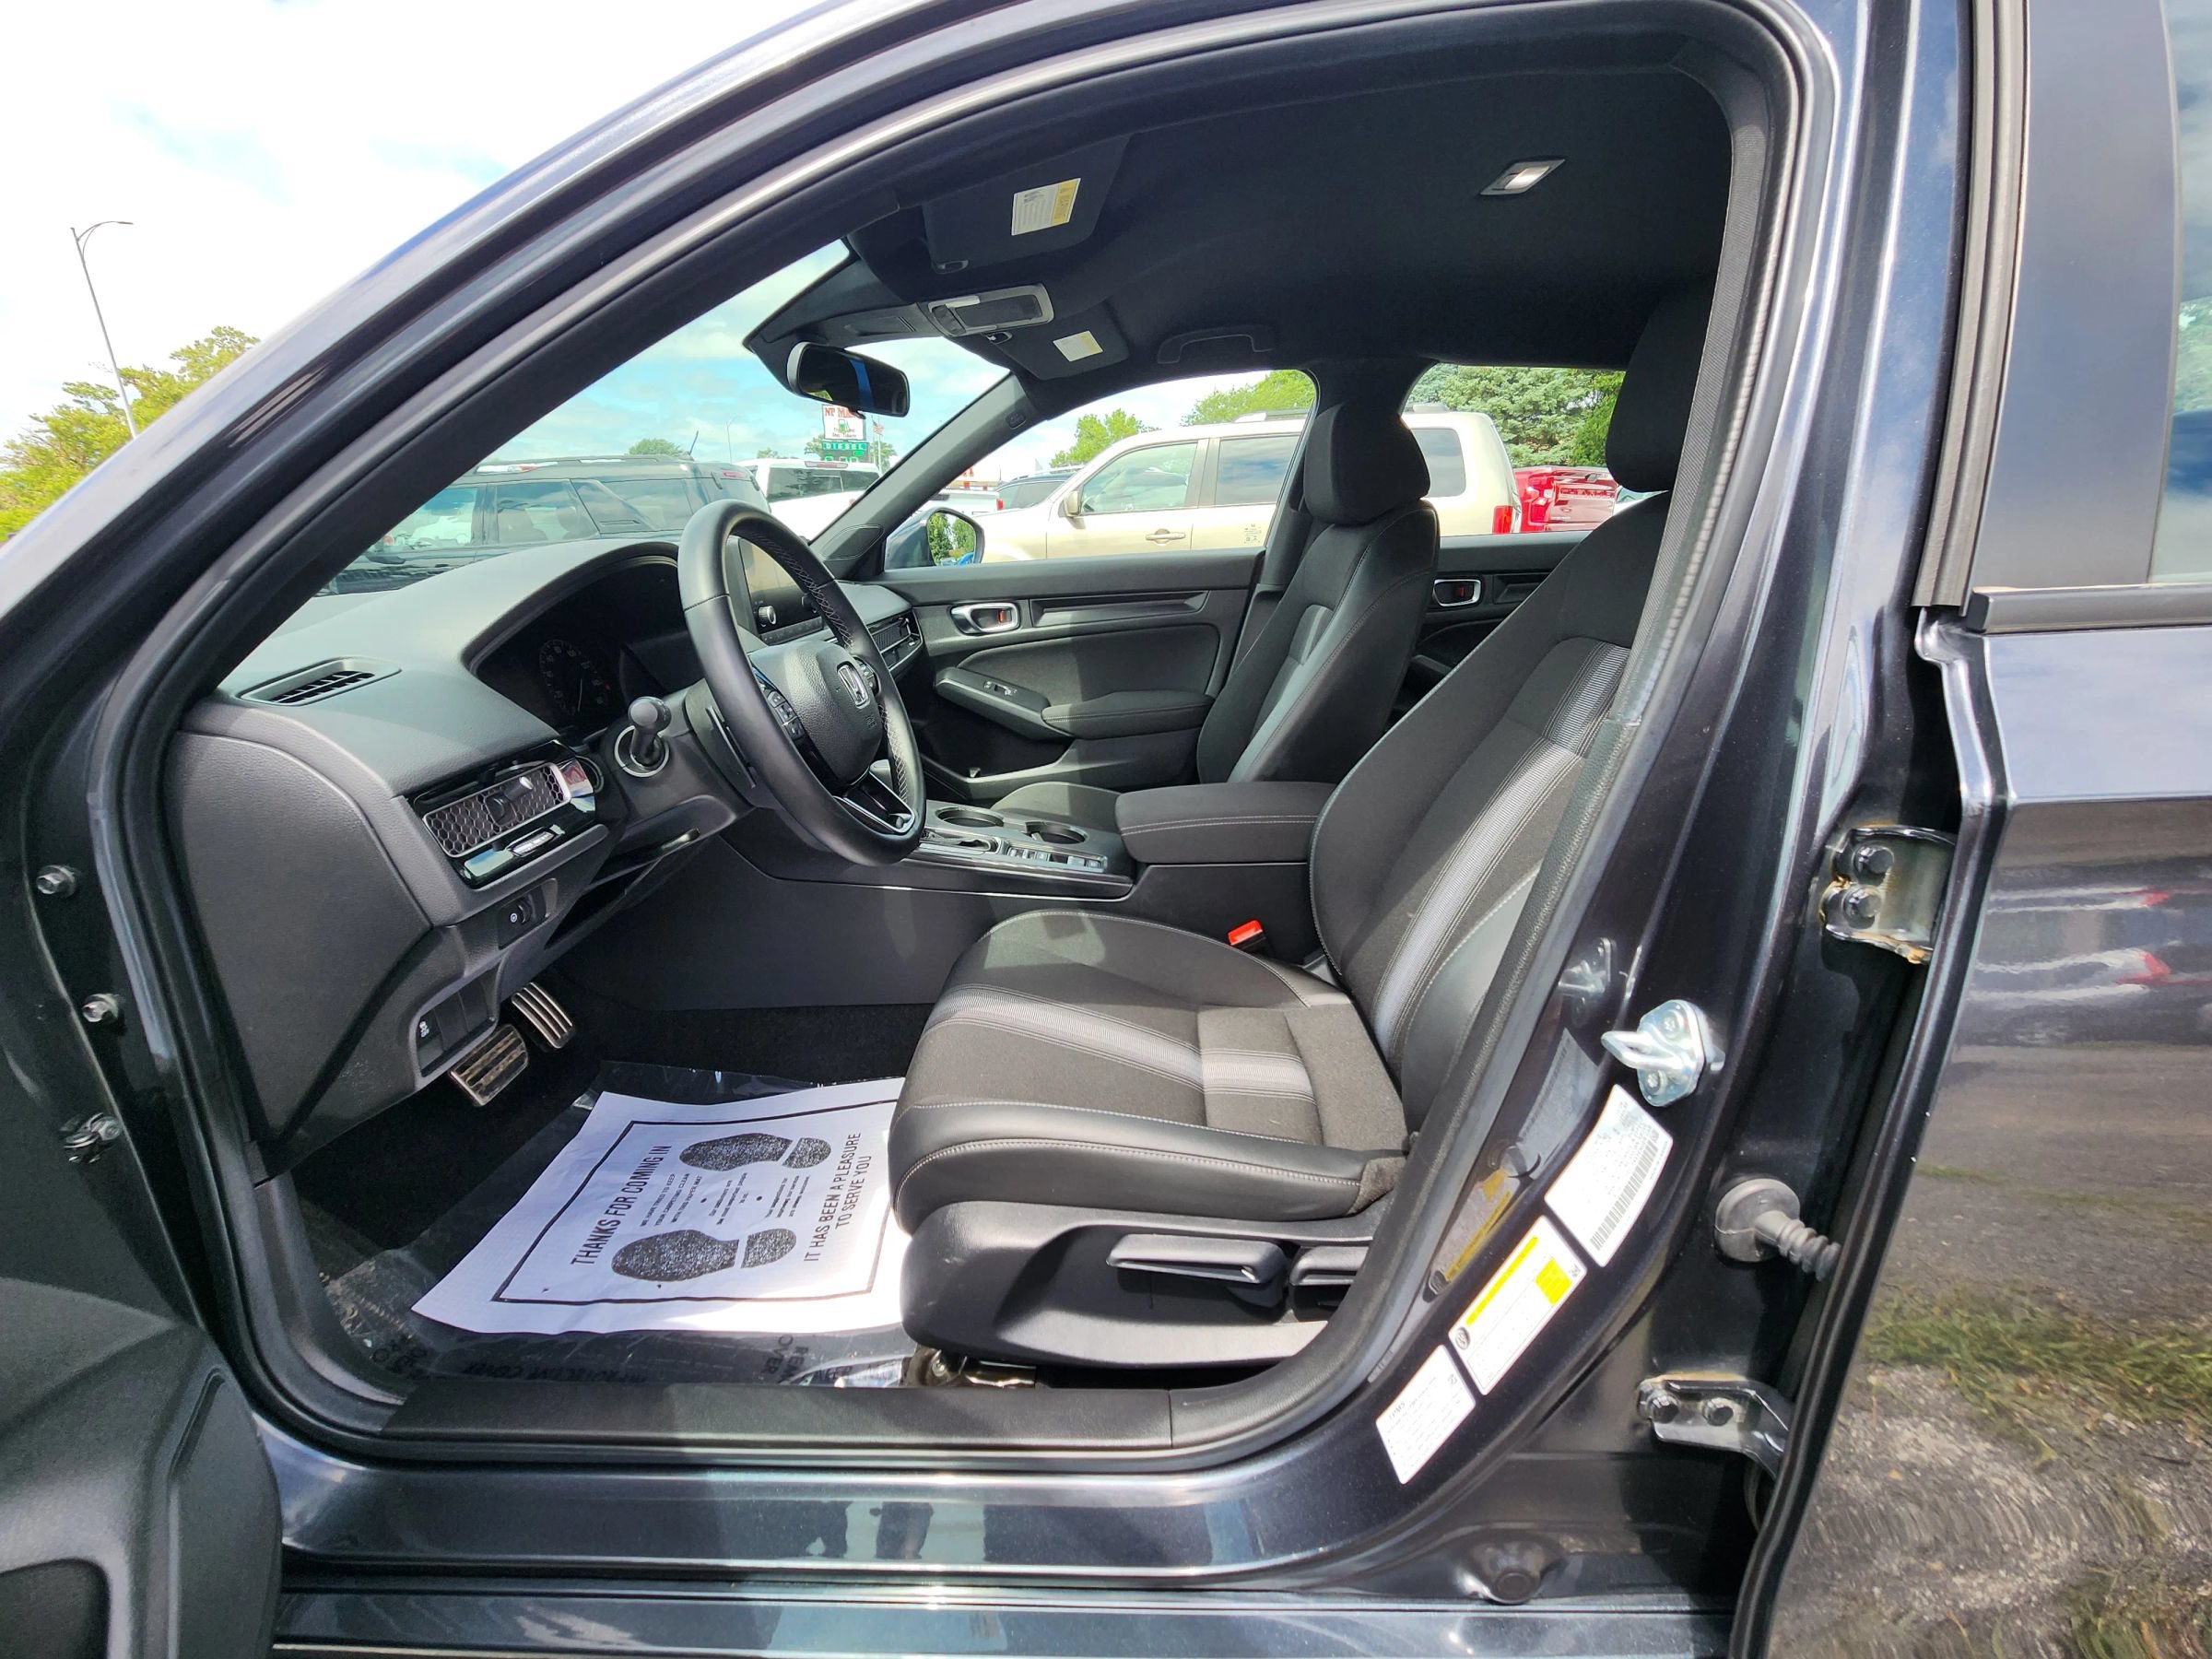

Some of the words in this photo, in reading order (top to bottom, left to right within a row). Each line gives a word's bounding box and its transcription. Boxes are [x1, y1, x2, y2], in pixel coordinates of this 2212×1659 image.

[648, 1146, 672, 1155] IN
[833, 1133, 862, 1182] PLEASURE
[620, 1157, 664, 1194] COMING
[853, 1156, 872, 1177] YOU
[841, 1178, 865, 1210] SERVE
[604, 1196, 638, 1217] FOR
[818, 1194, 841, 1222] BEEN
[835, 1213, 852, 1230] TO
[571, 1219, 621, 1265] THANKS
[809, 1225, 830, 1248] HAS
[804, 1252, 821, 1262] IT
